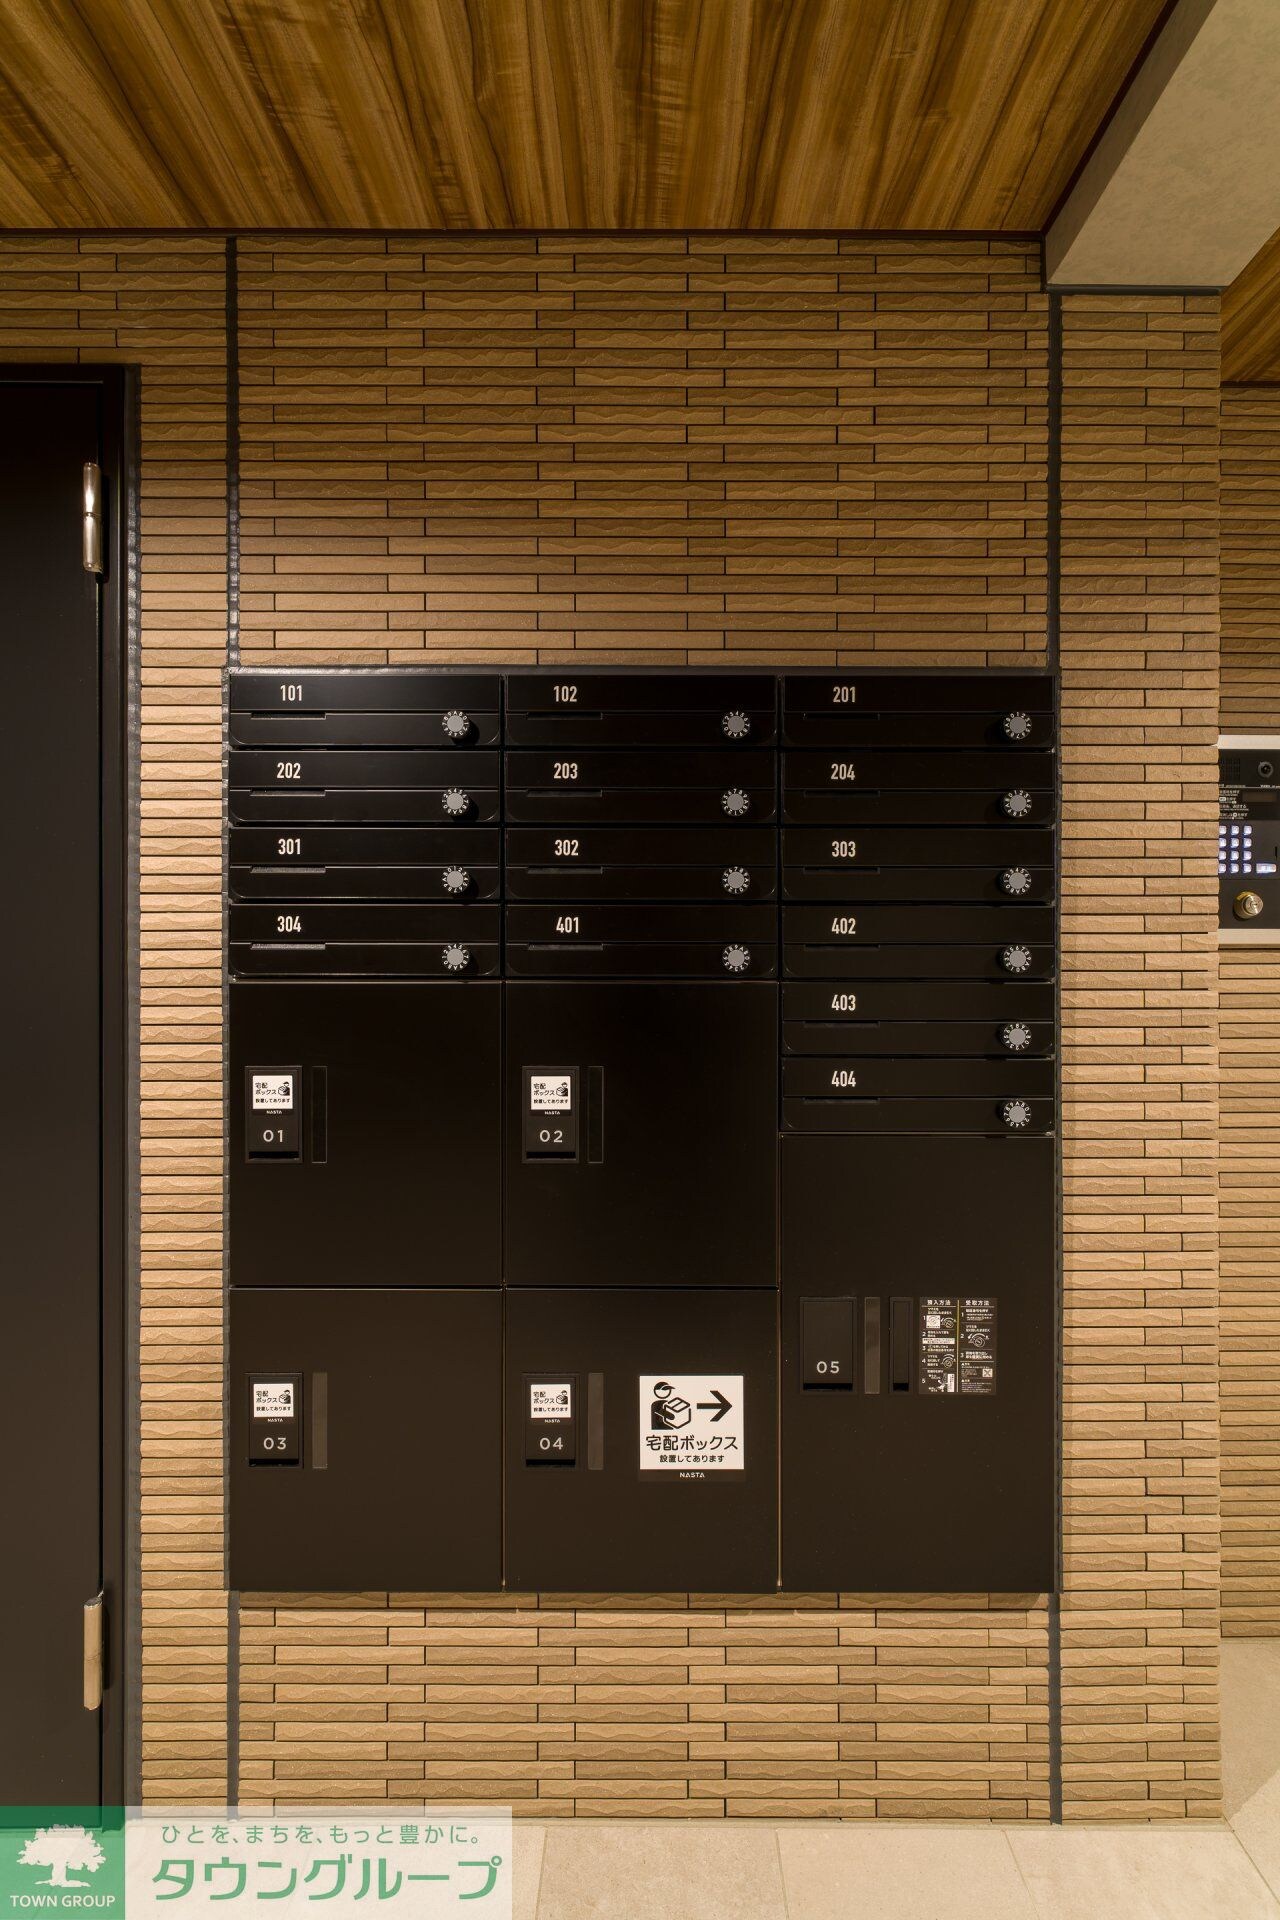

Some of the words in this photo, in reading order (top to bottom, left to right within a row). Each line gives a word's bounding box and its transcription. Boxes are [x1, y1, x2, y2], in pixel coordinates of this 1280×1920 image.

[280, 685, 303, 701] 101
[554, 686, 577, 702] 102
[833, 687, 855, 702] 201
[277, 762, 301, 778] 202
[554, 763, 577, 779] 203
[831, 764, 855, 780] 204
[278, 839, 300, 854] 301
[555, 840, 578, 855] 302
[832, 841, 855, 857] 303
[278, 916, 301, 932] 304
[556, 917, 578, 933] 401
[832, 918, 855, 934] 402
[832, 995, 855, 1011] 403
[832, 1071, 856, 1087] 404
[263, 1130, 283, 1142] 01
[540, 1130, 562, 1142] 02
[817, 1361, 839, 1373] 05
[264, 1438, 286, 1449] 03
[540, 1437, 563, 1450] 04
[645, 1434, 738, 1451] 宅配ボックス
[659, 1454, 725, 1463] 設置してあります
